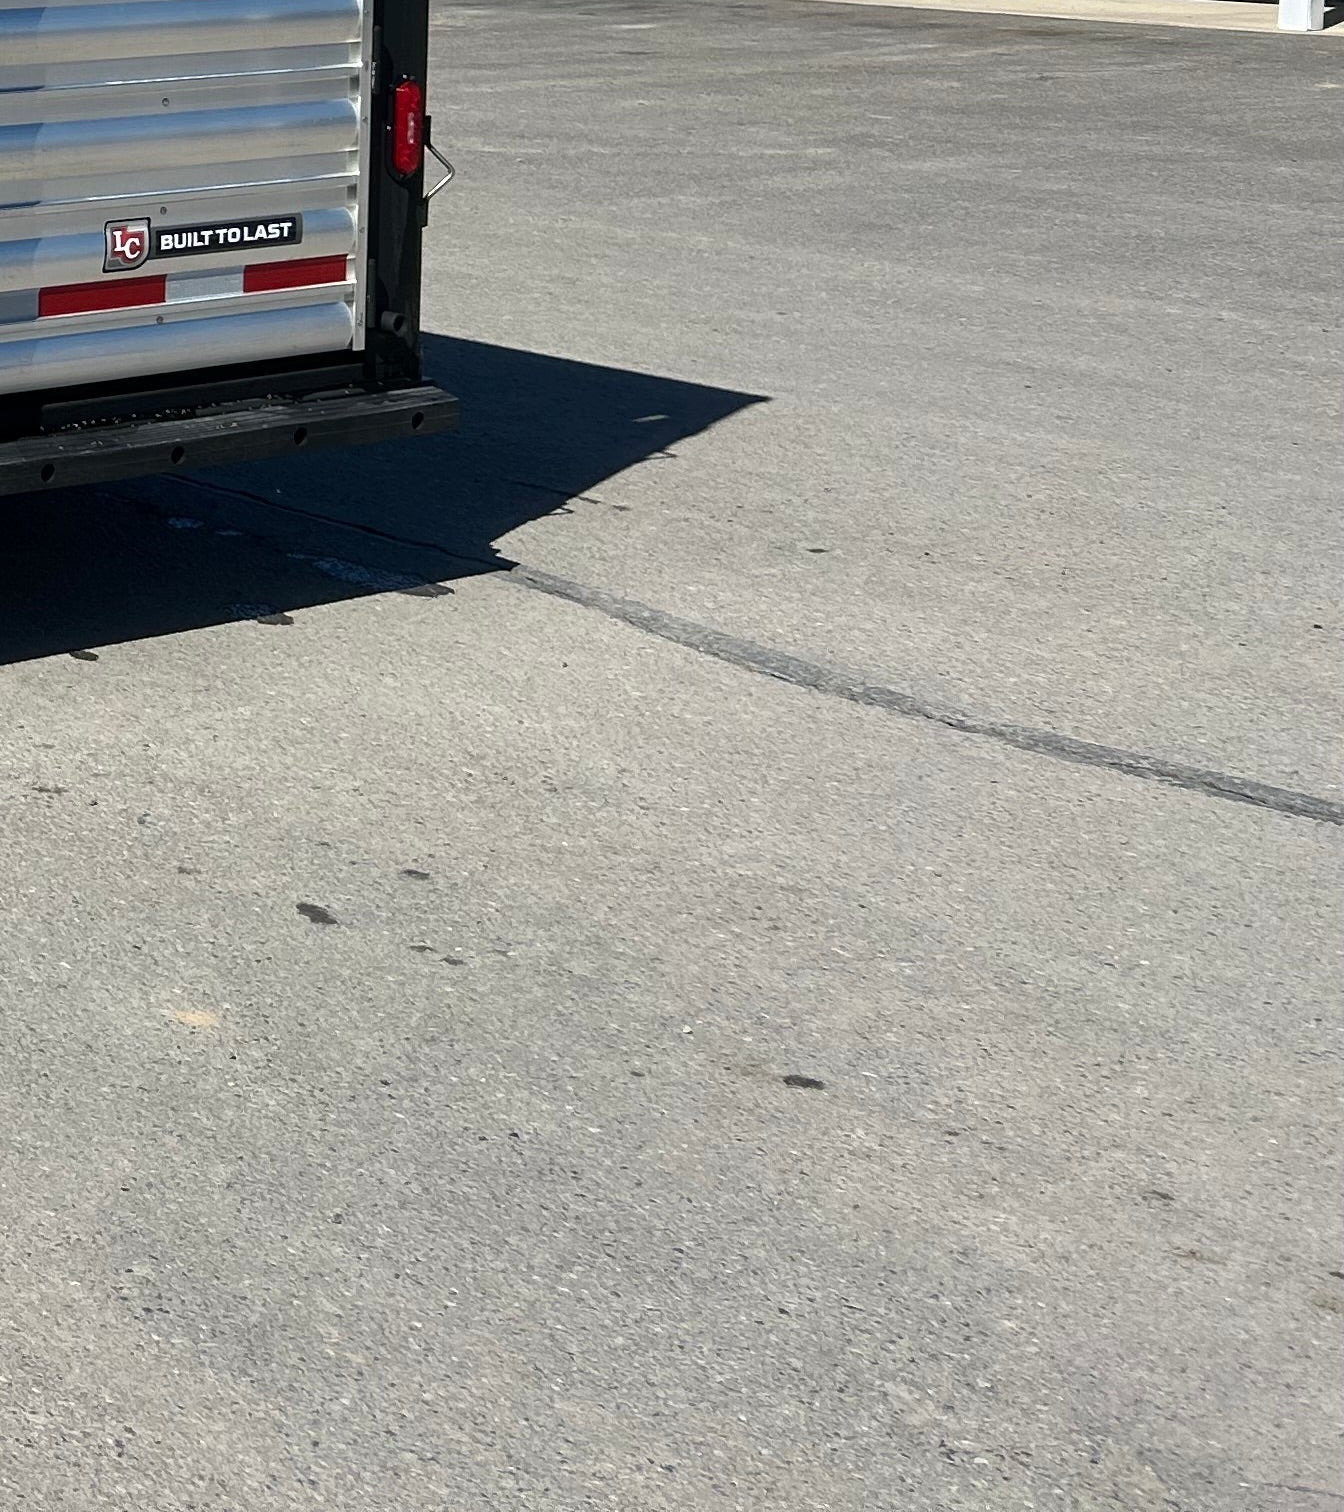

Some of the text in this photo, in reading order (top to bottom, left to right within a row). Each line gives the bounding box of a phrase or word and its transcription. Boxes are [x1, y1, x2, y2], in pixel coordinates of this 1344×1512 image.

[112, 222, 293, 260] LC BUILT TO LAST
